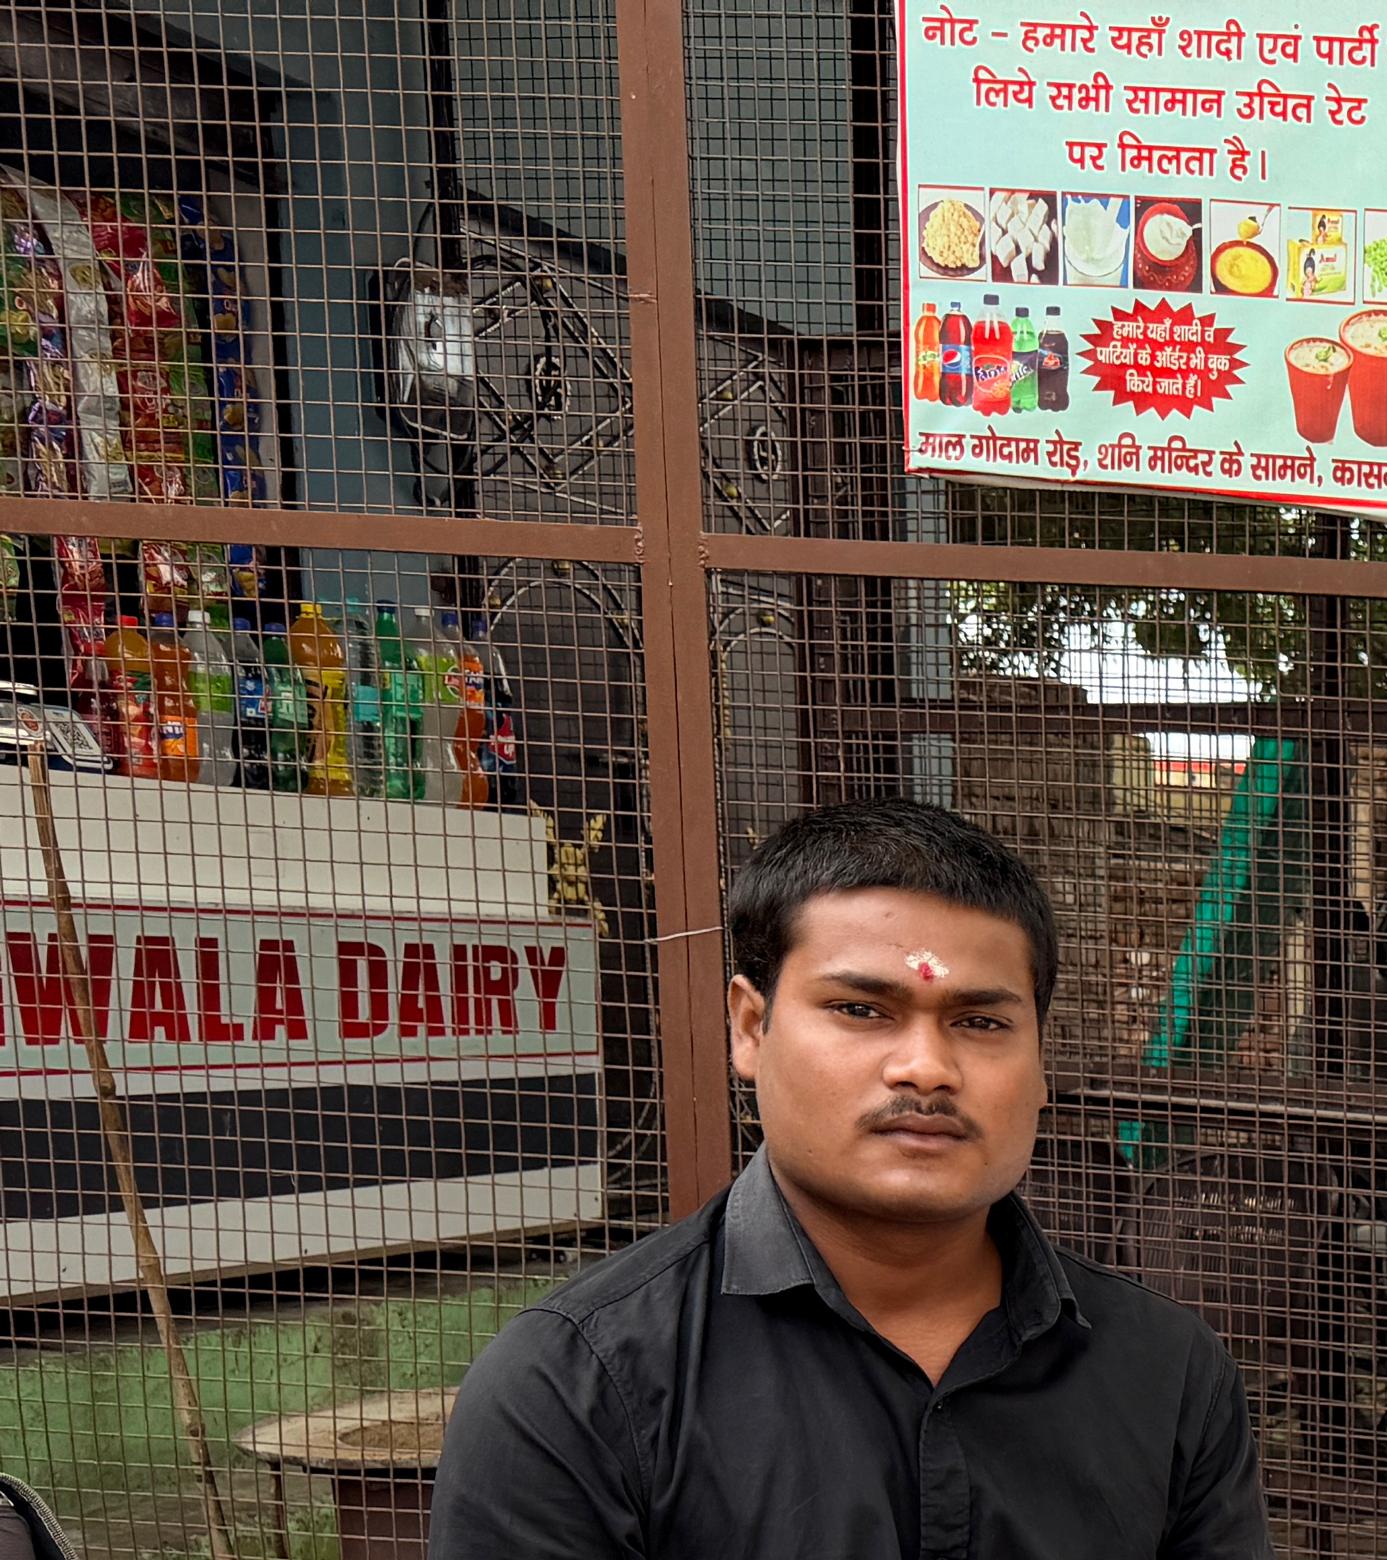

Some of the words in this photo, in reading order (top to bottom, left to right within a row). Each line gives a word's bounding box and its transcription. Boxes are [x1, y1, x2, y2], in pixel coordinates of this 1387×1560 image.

[923, 8, 978, 45] नोट
[1021, 12, 1098, 52] हमारे
[1109, 16, 1169, 58] यहाँ
[1179, 19, 1245, 60] शादी
[1257, 24, 1301, 66] एवं
[1313, 24, 1379, 66] पार्टी
[973, 66, 1036, 108] लिये
[1047, 72, 1113, 112] सभी
[1124, 86, 1225, 117] सामान
[1236, 79, 1314, 122] उचित
[1326, 83, 1367, 125] रेट
[1066, 142, 1107, 170] पर
[1118, 131, 1217, 176] मिलता
[1111, 314, 1144, 339] हमारे
[1147, 318, 1171, 342] यहाँ
[1174, 319, 1201, 342] शादी
[1205, 325, 1218, 343] व
[1138, 345, 1151, 365] के
[1155, 346, 1187, 369] ऑर्डर
[1190, 347, 1205, 369] भी
[1126, 370, 1153, 392] किये
[1157, 374, 1182, 395] जाते
[919, 431, 966, 461] माल
[971, 425, 1039, 463] गोदाम
[1098, 433, 1141, 470] शनि
[1148, 436, 1215, 476] मन्दिर
[1220, 441, 1244, 477] के
[0, 931, 308, 1046] WALA
[338, 941, 567, 1039] DAIRY
